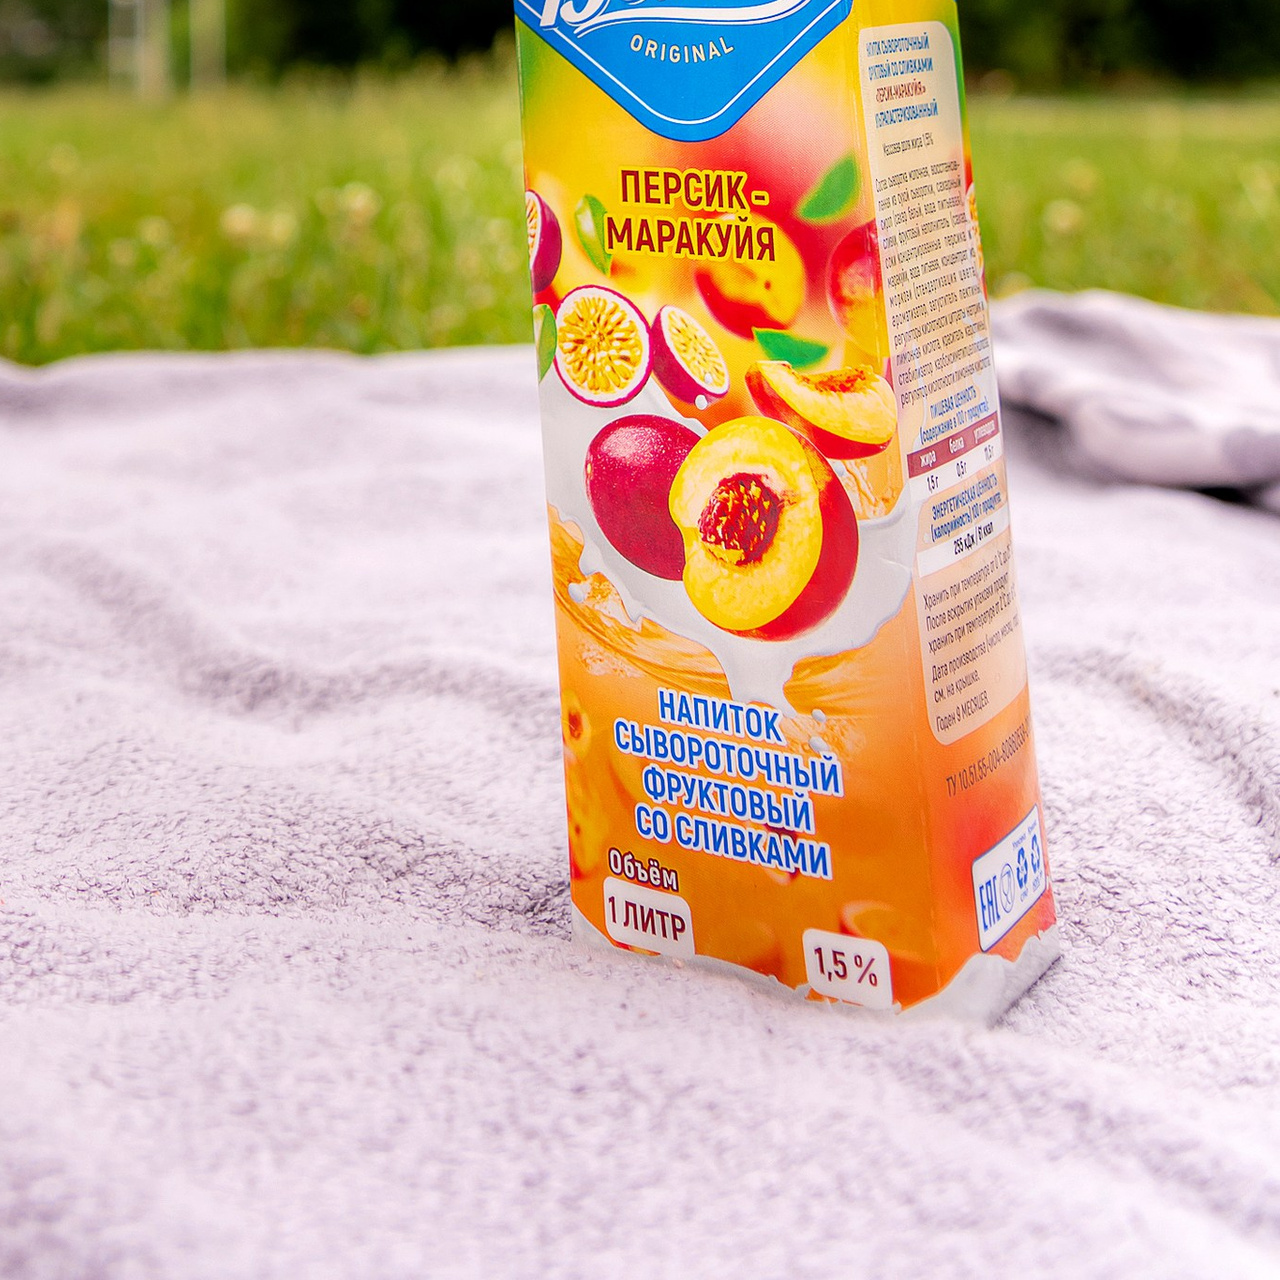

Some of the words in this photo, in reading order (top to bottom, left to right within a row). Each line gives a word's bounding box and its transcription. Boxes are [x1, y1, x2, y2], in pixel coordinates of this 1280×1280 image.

[630, 34, 735, 63] ORIGINAL
[606, 215, 776, 262] МАРАКУЙЯ
[658, 689, 784, 743] НАПИТОК
[614, 720, 841, 795] СЫВОРОТОЧНЫЙ
[643, 766, 813, 832] ФРУКТОВЫЙ
[636, 806, 668, 841] СО
[675, 815, 830, 878] СЛИВКАМИ
[608, 847, 680, 892] Объём
[607, 895, 618, 924] 1
[623, 899, 687, 942] ЛИТР
